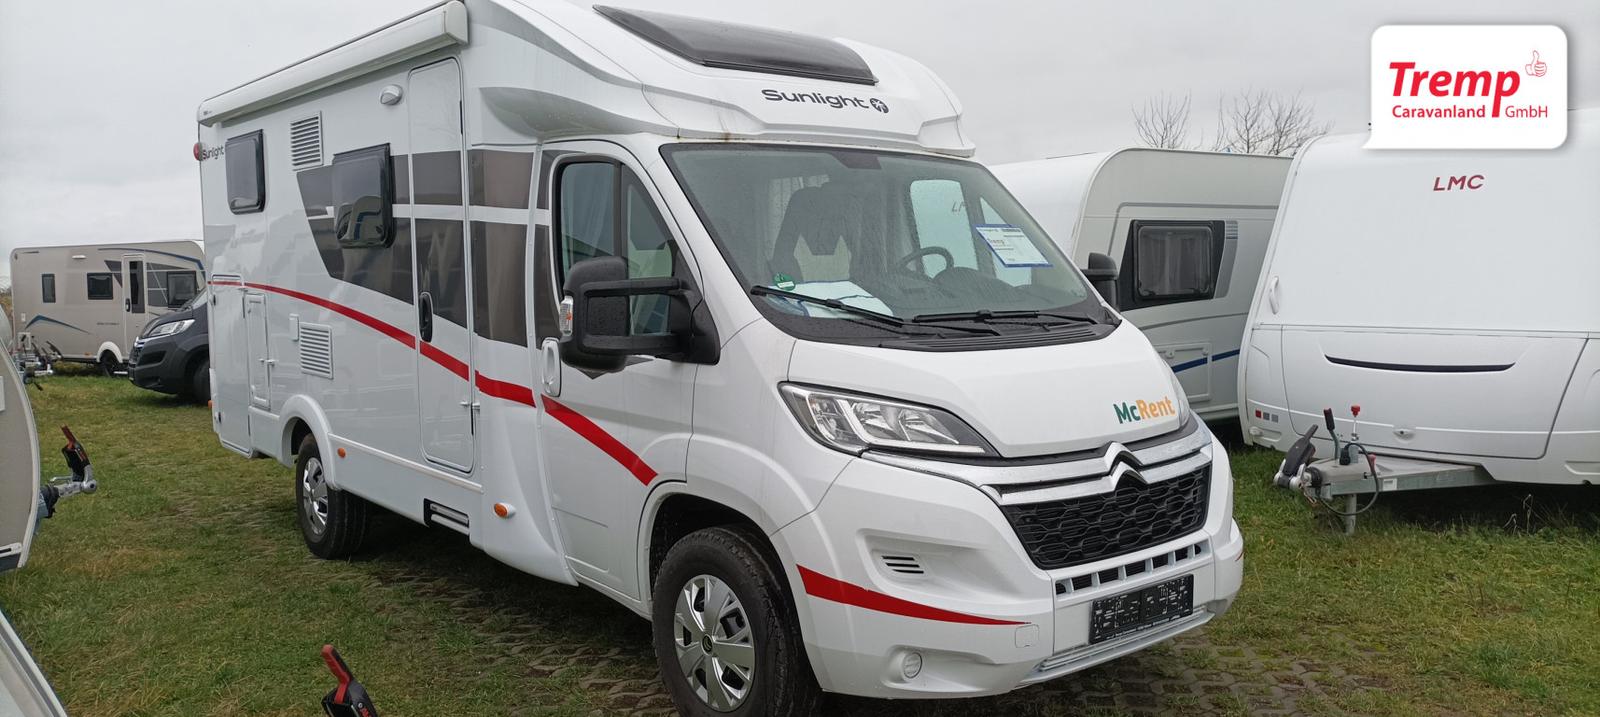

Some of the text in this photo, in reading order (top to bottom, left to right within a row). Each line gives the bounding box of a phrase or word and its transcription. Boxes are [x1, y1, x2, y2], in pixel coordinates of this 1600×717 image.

[761, 88, 869, 109] Sunlight
[202, 145, 224, 160] Sunlight
[1433, 174, 1485, 191] LMC
[1113, 396, 1175, 424] McRent
